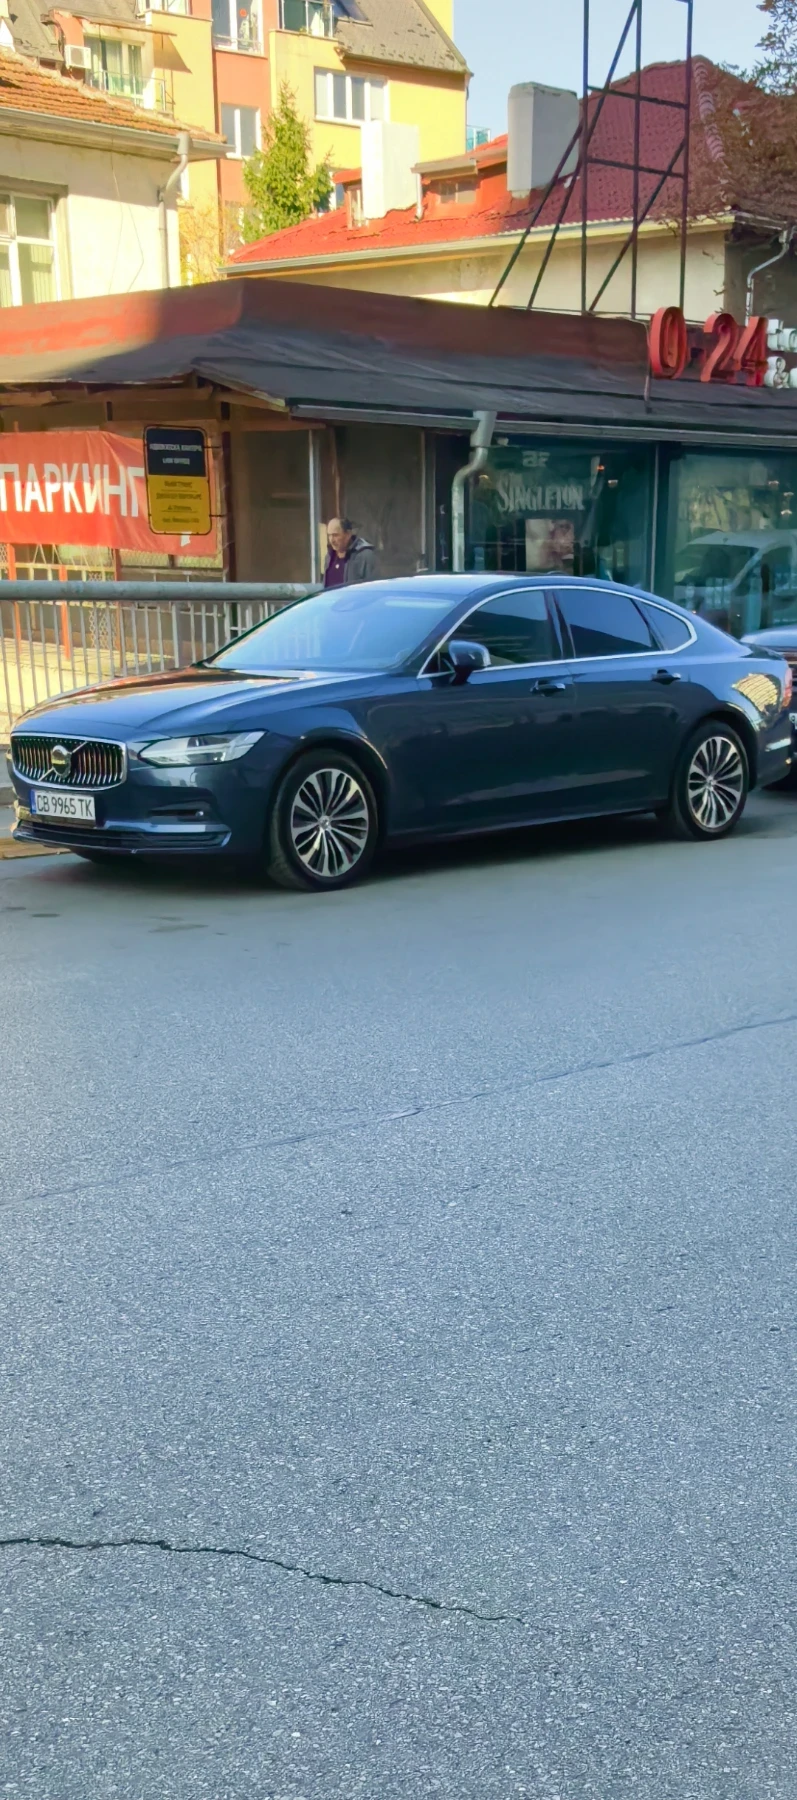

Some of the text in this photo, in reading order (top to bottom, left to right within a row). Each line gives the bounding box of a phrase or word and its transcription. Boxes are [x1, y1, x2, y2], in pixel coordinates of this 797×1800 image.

[0, 462, 145, 518] ПАРКИНГ
[36, 794, 93, 817] CB 9965 TK
